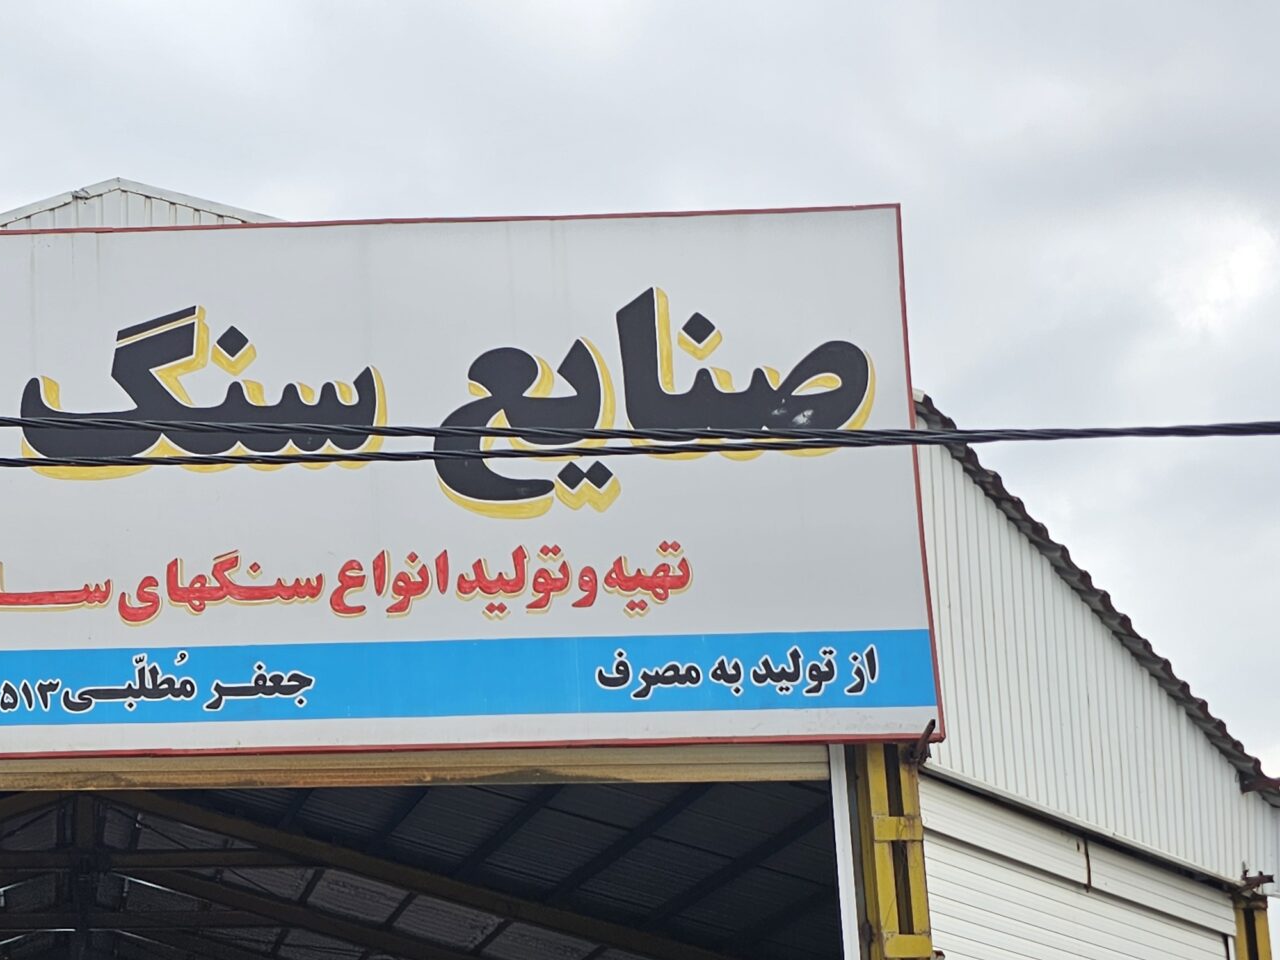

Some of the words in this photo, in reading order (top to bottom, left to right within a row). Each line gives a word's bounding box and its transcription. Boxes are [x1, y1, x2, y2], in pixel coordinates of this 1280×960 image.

[19, 304, 387, 481] سنگ
[433, 286, 876, 519] صنایع
[117, 550, 325, 625] سنگهای
[330, 551, 451, 615] انواع
[456, 544, 571, 616] تولید
[573, 565, 598, 608] و
[602, 541, 692, 612] تهیه
[204, 662, 315, 710] جعفر
[596, 648, 703, 699] مصرف
[709, 655, 743, 695] به
[750, 645, 836, 695] تولید
[843, 645, 879, 695] از
